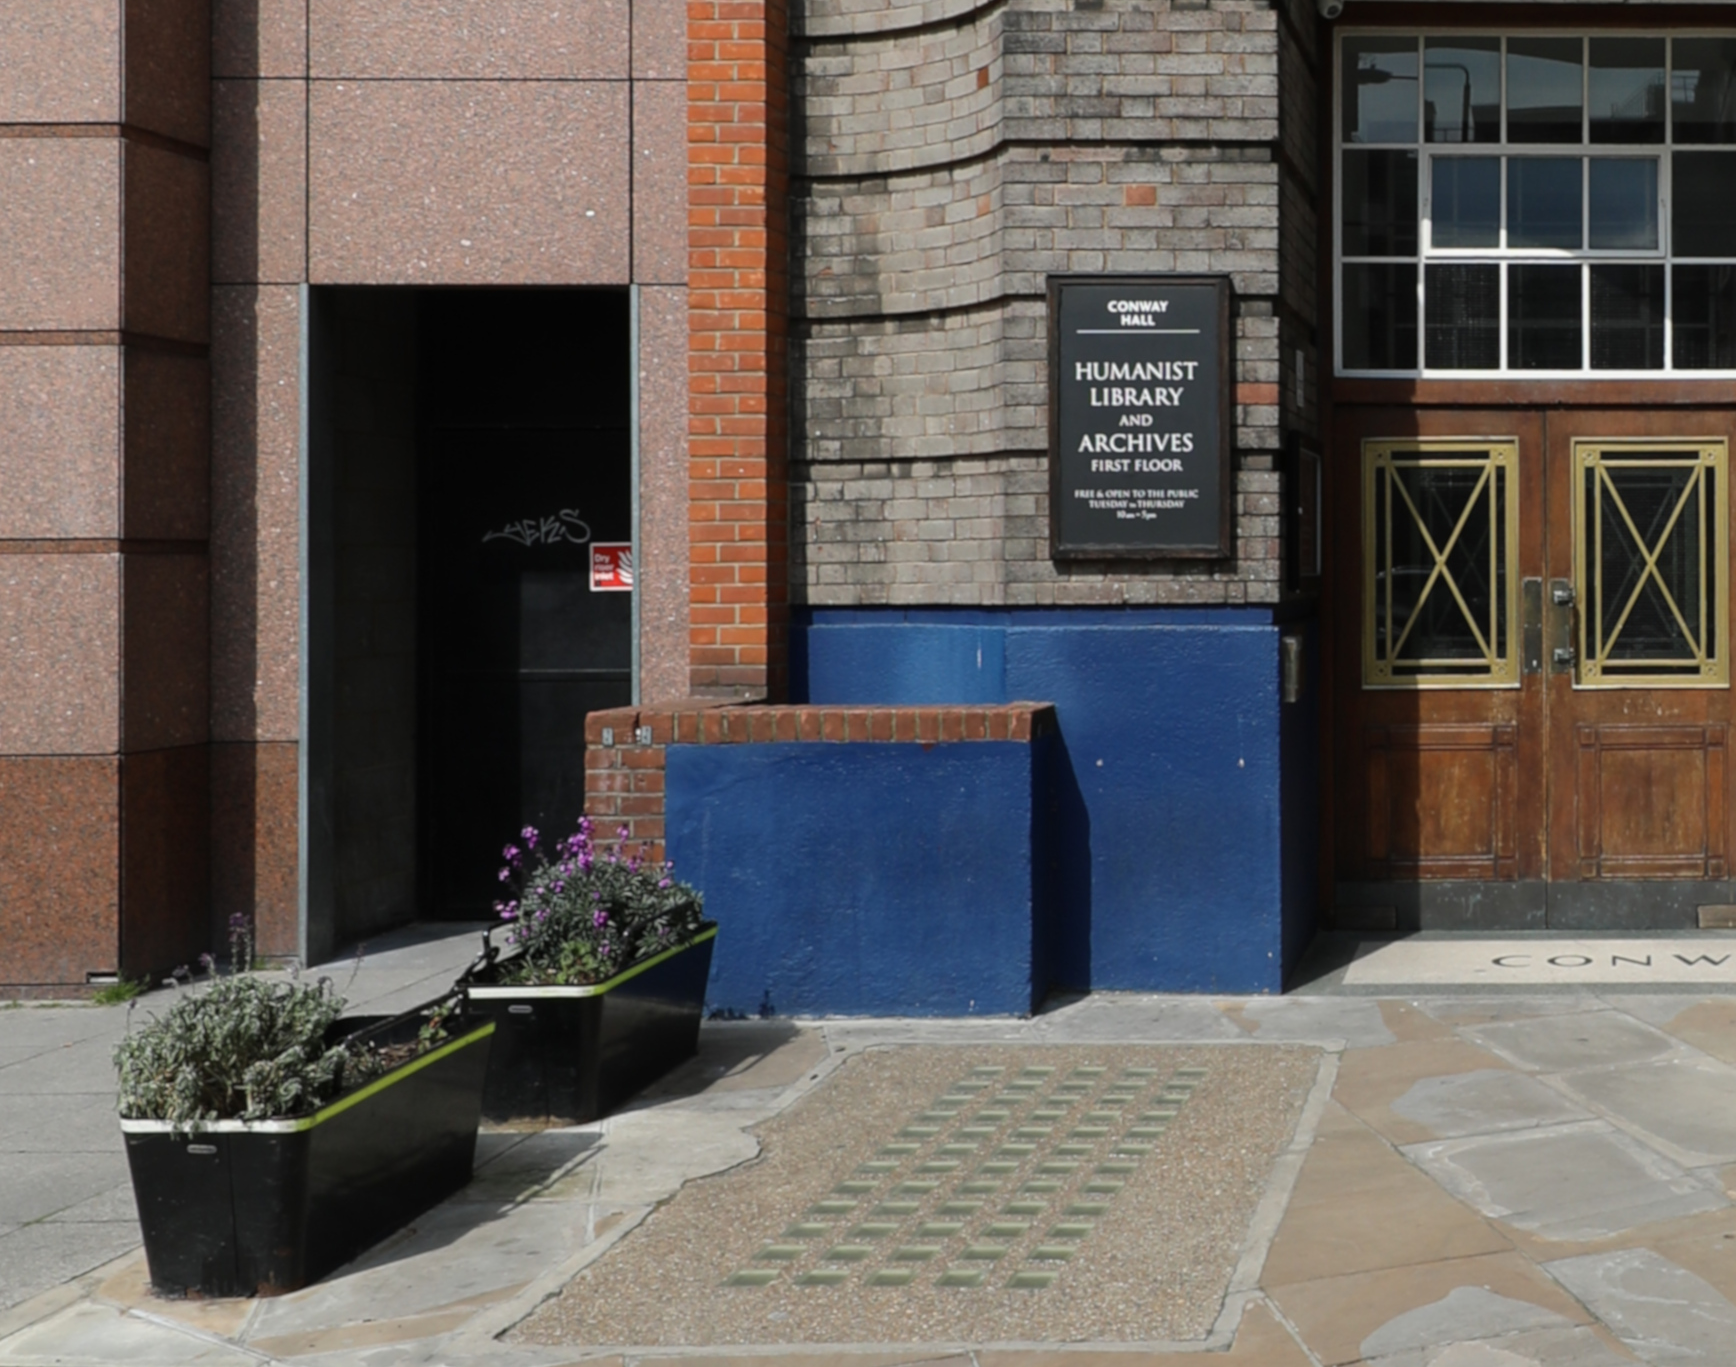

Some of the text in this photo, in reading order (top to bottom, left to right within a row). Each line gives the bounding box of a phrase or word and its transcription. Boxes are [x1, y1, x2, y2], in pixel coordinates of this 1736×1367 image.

[1107, 300, 1169, 313] CONWAY
[1120, 314, 1156, 326] HALL
[1075, 361, 1199, 381] HUMANIST
[1090, 387, 1185, 407] LIBRARY
[1119, 413, 1153, 427] AND
[1078, 433, 1194, 453] ARCHIVES
[1091, 459, 1183, 472] FIRST FLOOR
[1074, 489, 1199, 498] FREE & OPEN TO THE PUBLIC
[1088, 500, 1129, 509] TUESDAY
[1137, 500, 1185, 509] THURSDAY
[594, 553, 610, 563] Dry
